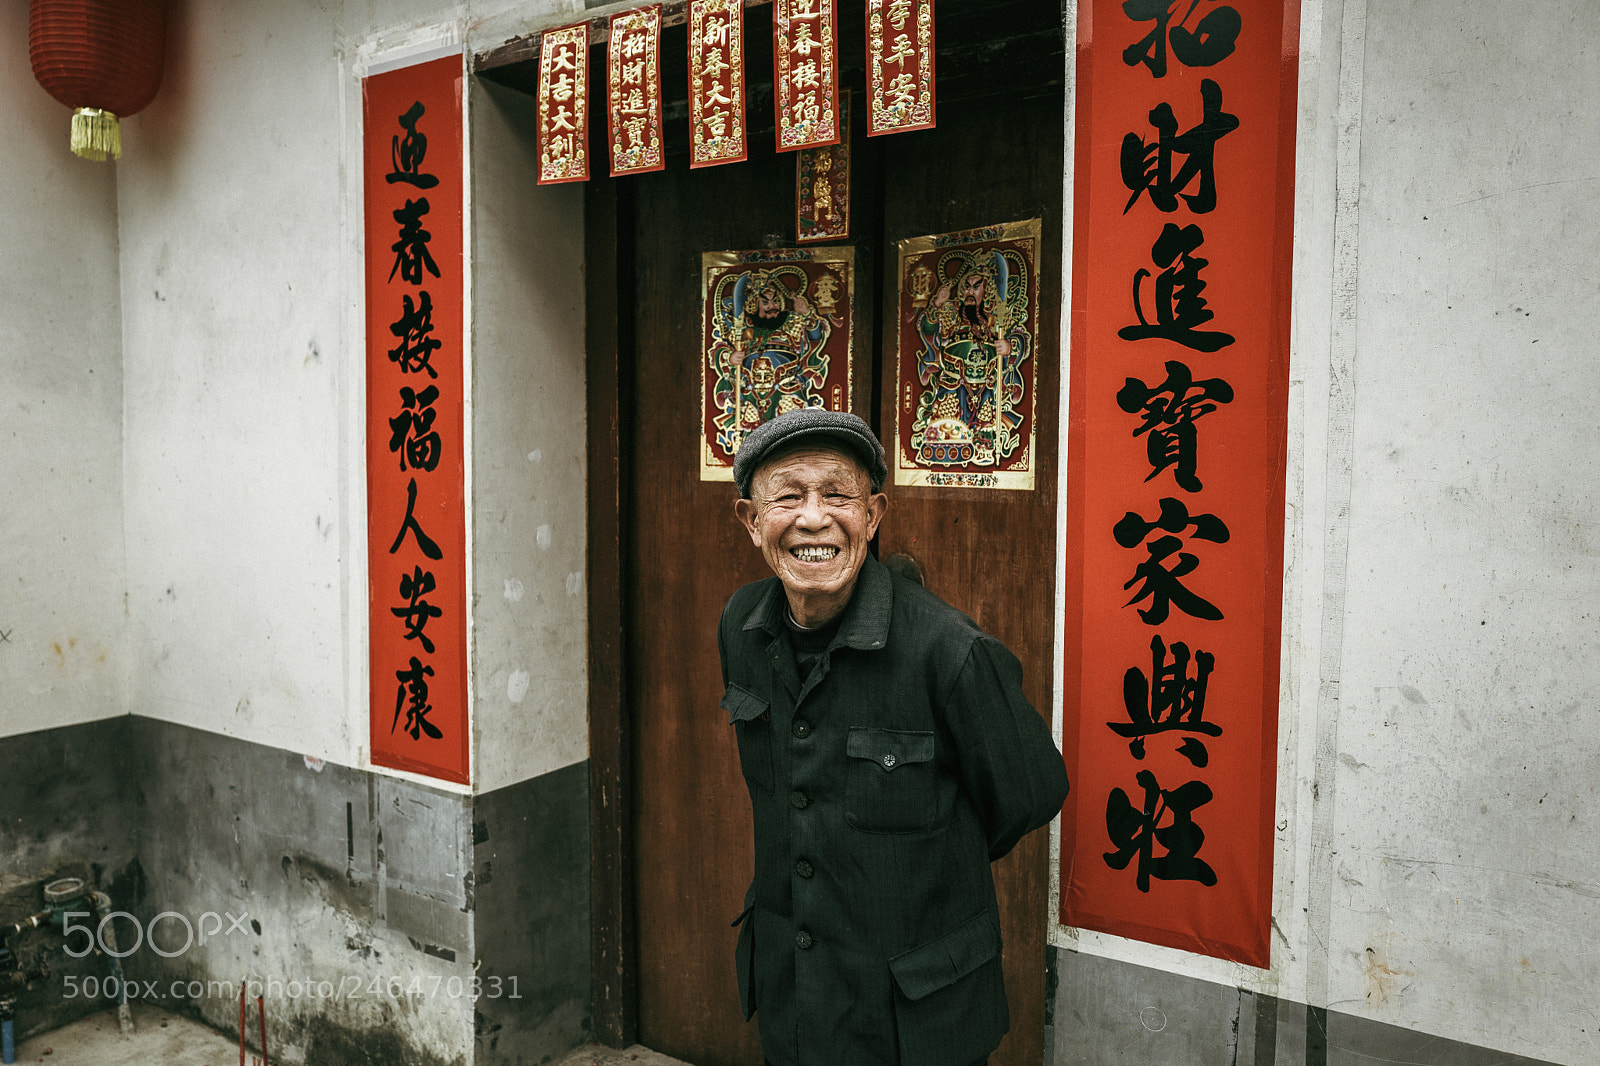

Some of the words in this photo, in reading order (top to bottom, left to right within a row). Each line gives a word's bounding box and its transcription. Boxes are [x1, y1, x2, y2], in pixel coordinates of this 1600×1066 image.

[549, 46, 576, 161] 大吉大利
[621, 32, 648, 148] 招財進寶
[700, 16, 731, 137] 新春大吉
[385, 101, 443, 741] 迎春接福人安康
[1102, 0, 1242, 893] 招財進寶家興旺
